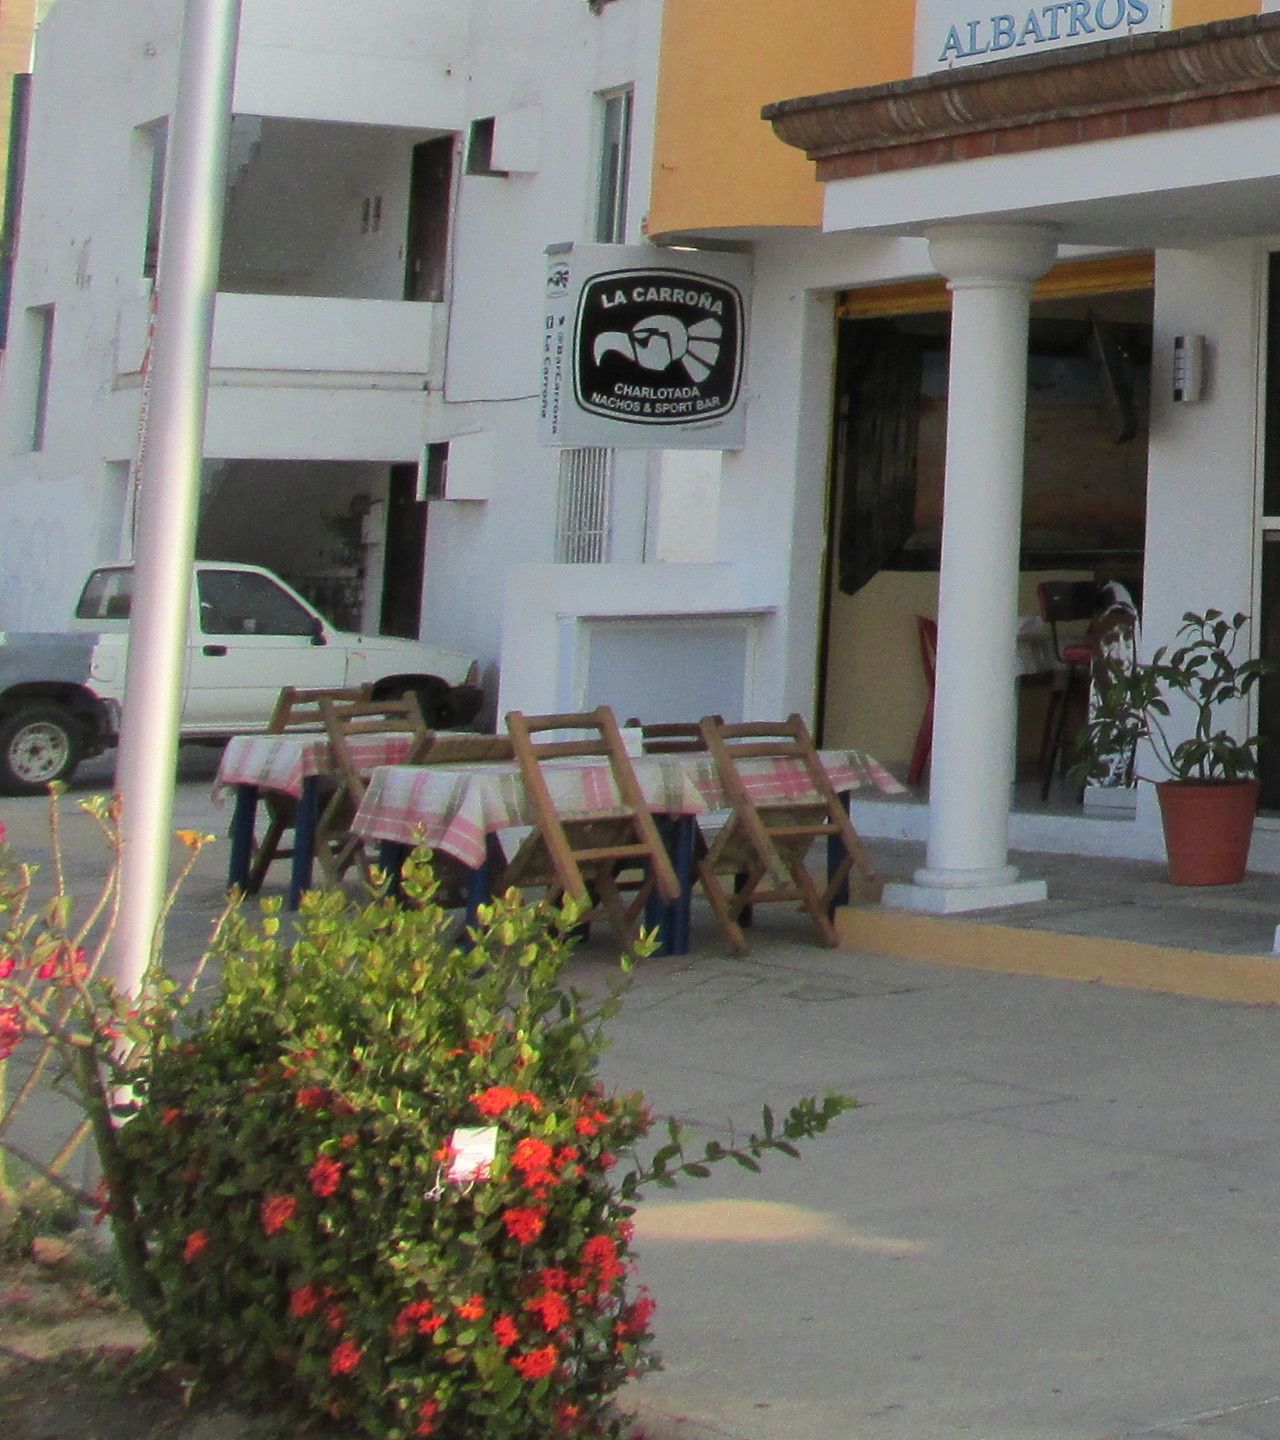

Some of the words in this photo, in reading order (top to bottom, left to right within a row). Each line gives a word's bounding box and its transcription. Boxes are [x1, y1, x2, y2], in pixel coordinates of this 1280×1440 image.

[600, 288, 628, 309] LA
[631, 286, 723, 315] CARROÑA
[613, 382, 701, 399] CHARLOTADA
[591, 391, 641, 412] NACHOS
[643, 401, 650, 413] &
[654, 401, 693, 413] SPORT
[696, 396, 721, 410] BAR
